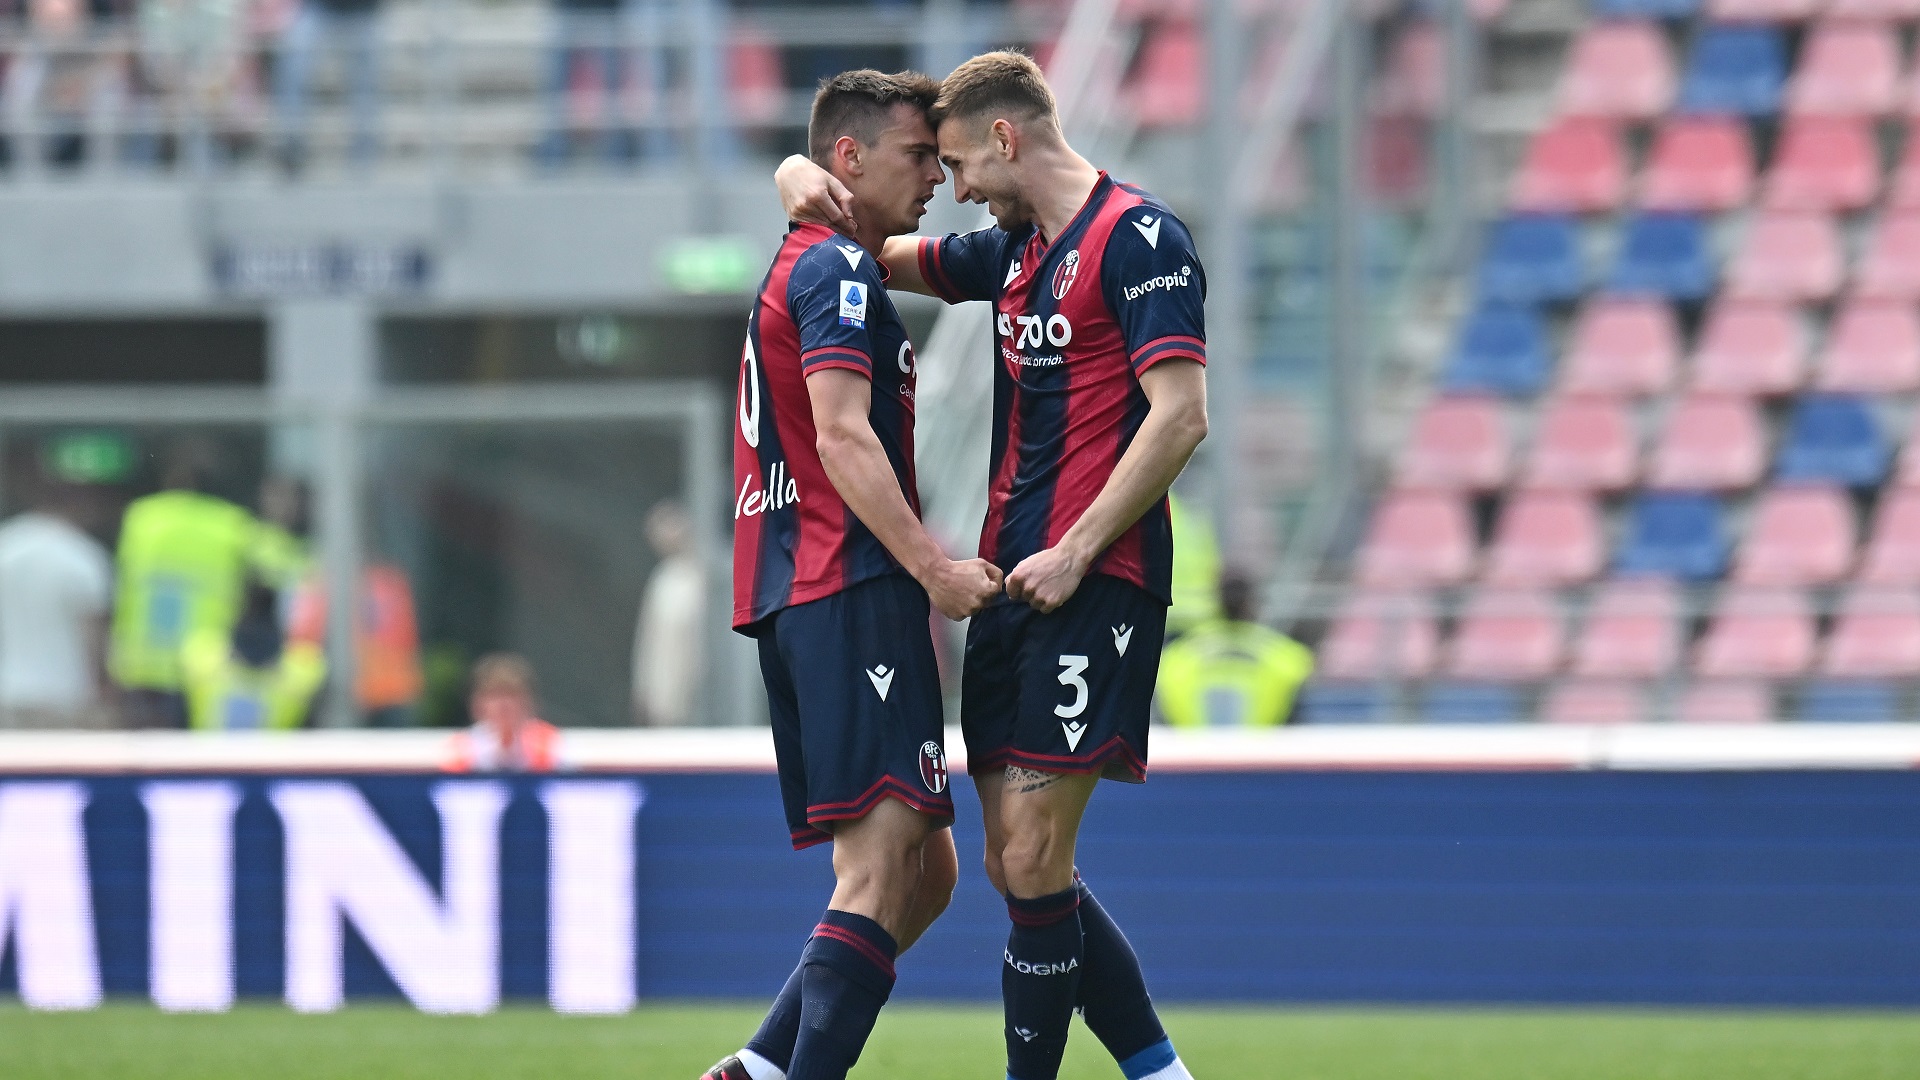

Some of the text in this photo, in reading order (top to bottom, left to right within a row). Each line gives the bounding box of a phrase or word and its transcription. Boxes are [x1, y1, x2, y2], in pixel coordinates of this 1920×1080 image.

[851, 319, 862, 328] TIM
[1053, 655, 1089, 719] 3
[925, 743, 939, 755] BFC
